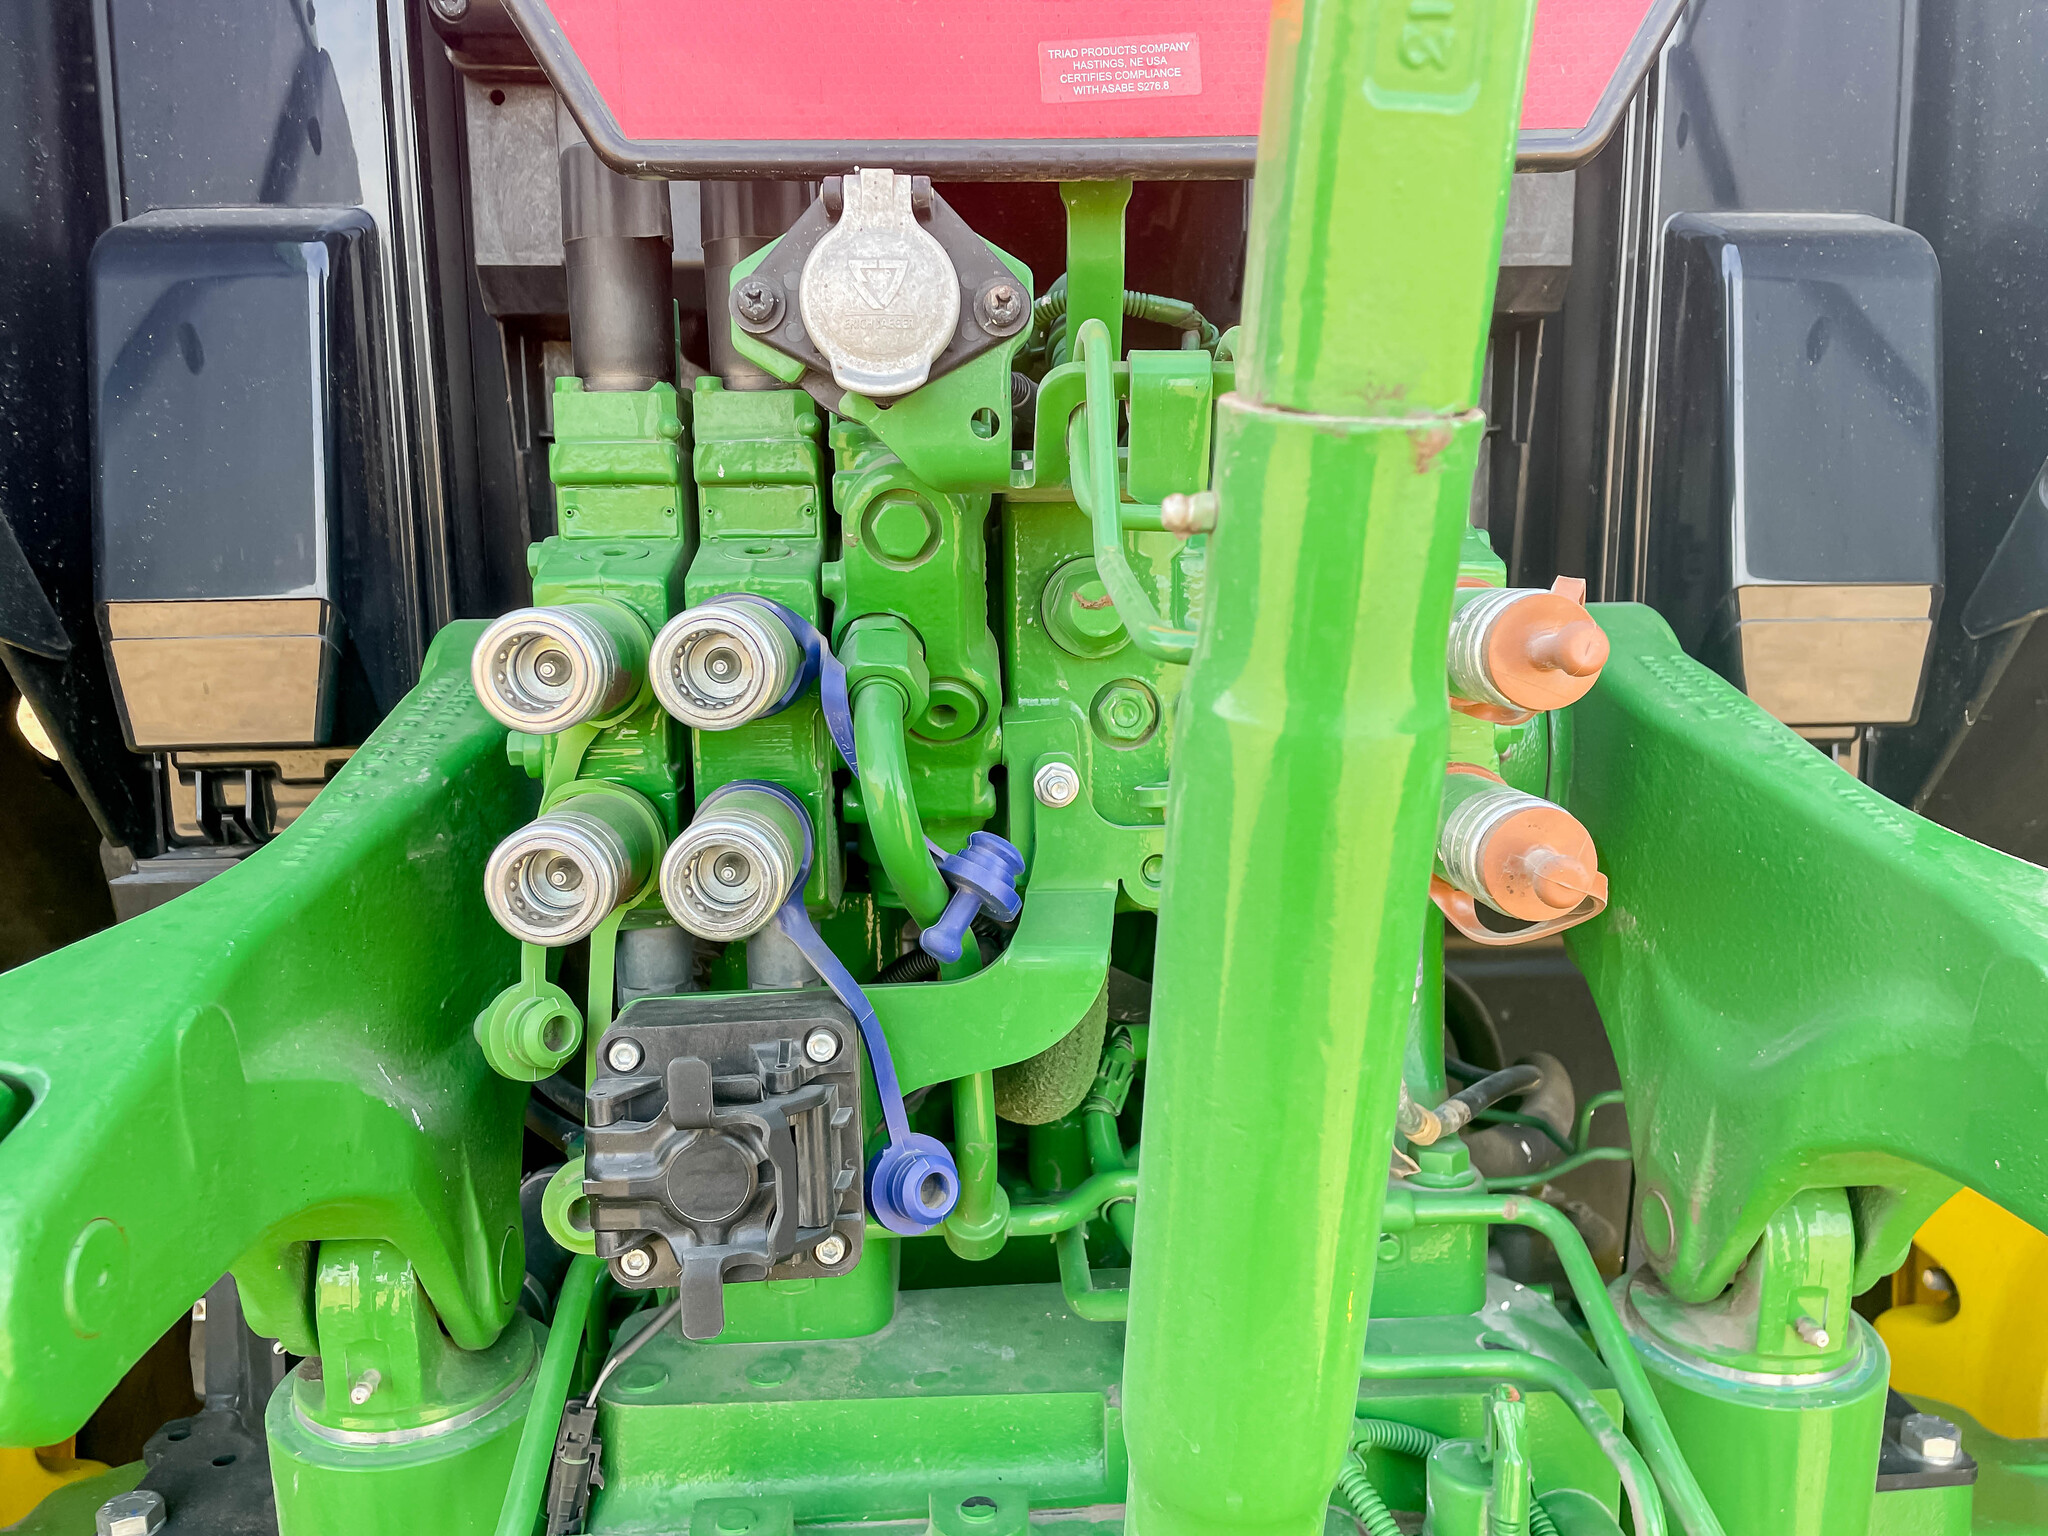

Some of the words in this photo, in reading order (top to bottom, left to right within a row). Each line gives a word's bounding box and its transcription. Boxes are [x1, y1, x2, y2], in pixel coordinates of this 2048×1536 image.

[1048, 48, 1079, 59] TRIAD
[1081, 45, 1138, 57] PRODUCTS
[1139, 41, 1190, 54] COMPANY
[1073, 58, 1127, 70] HASTINGS,
[1129, 57, 1143, 67] NE
[1146, 56, 1168, 66] USA
[1059, 71, 1113, 84] CERTIFIES
[1114, 67, 1181, 80] COMPLIANCE
[1073, 85, 1099, 95] WITH
[1101, 82, 1135, 94] ASABE
[1137, 81, 1170, 91] S276.8
[844, 318, 873, 330] ERICH
[875, 318, 915, 330] JAEGER
